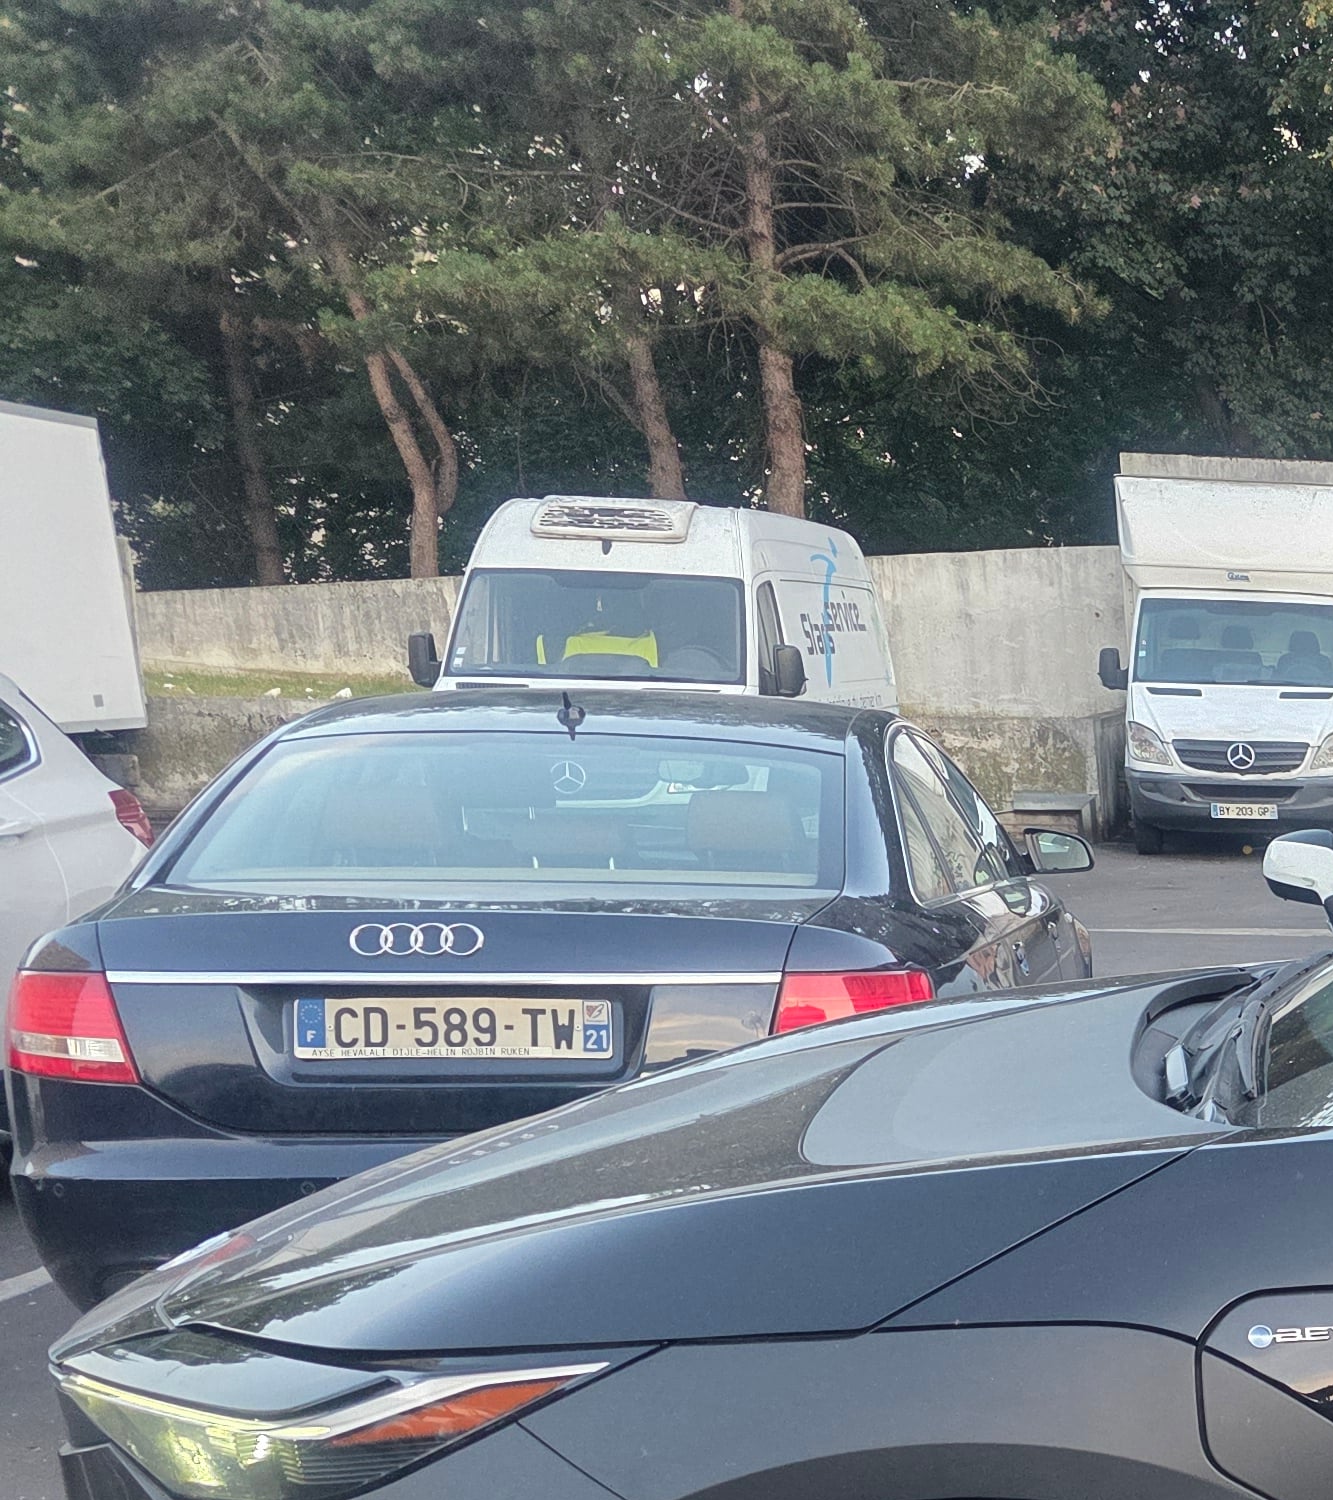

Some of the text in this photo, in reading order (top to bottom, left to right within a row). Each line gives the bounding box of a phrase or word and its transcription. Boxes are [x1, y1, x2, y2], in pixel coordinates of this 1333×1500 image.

[306, 1030, 317, 1043] F
[334, 1006, 575, 1050] CD-589-TW
[586, 1029, 608, 1049] 21
